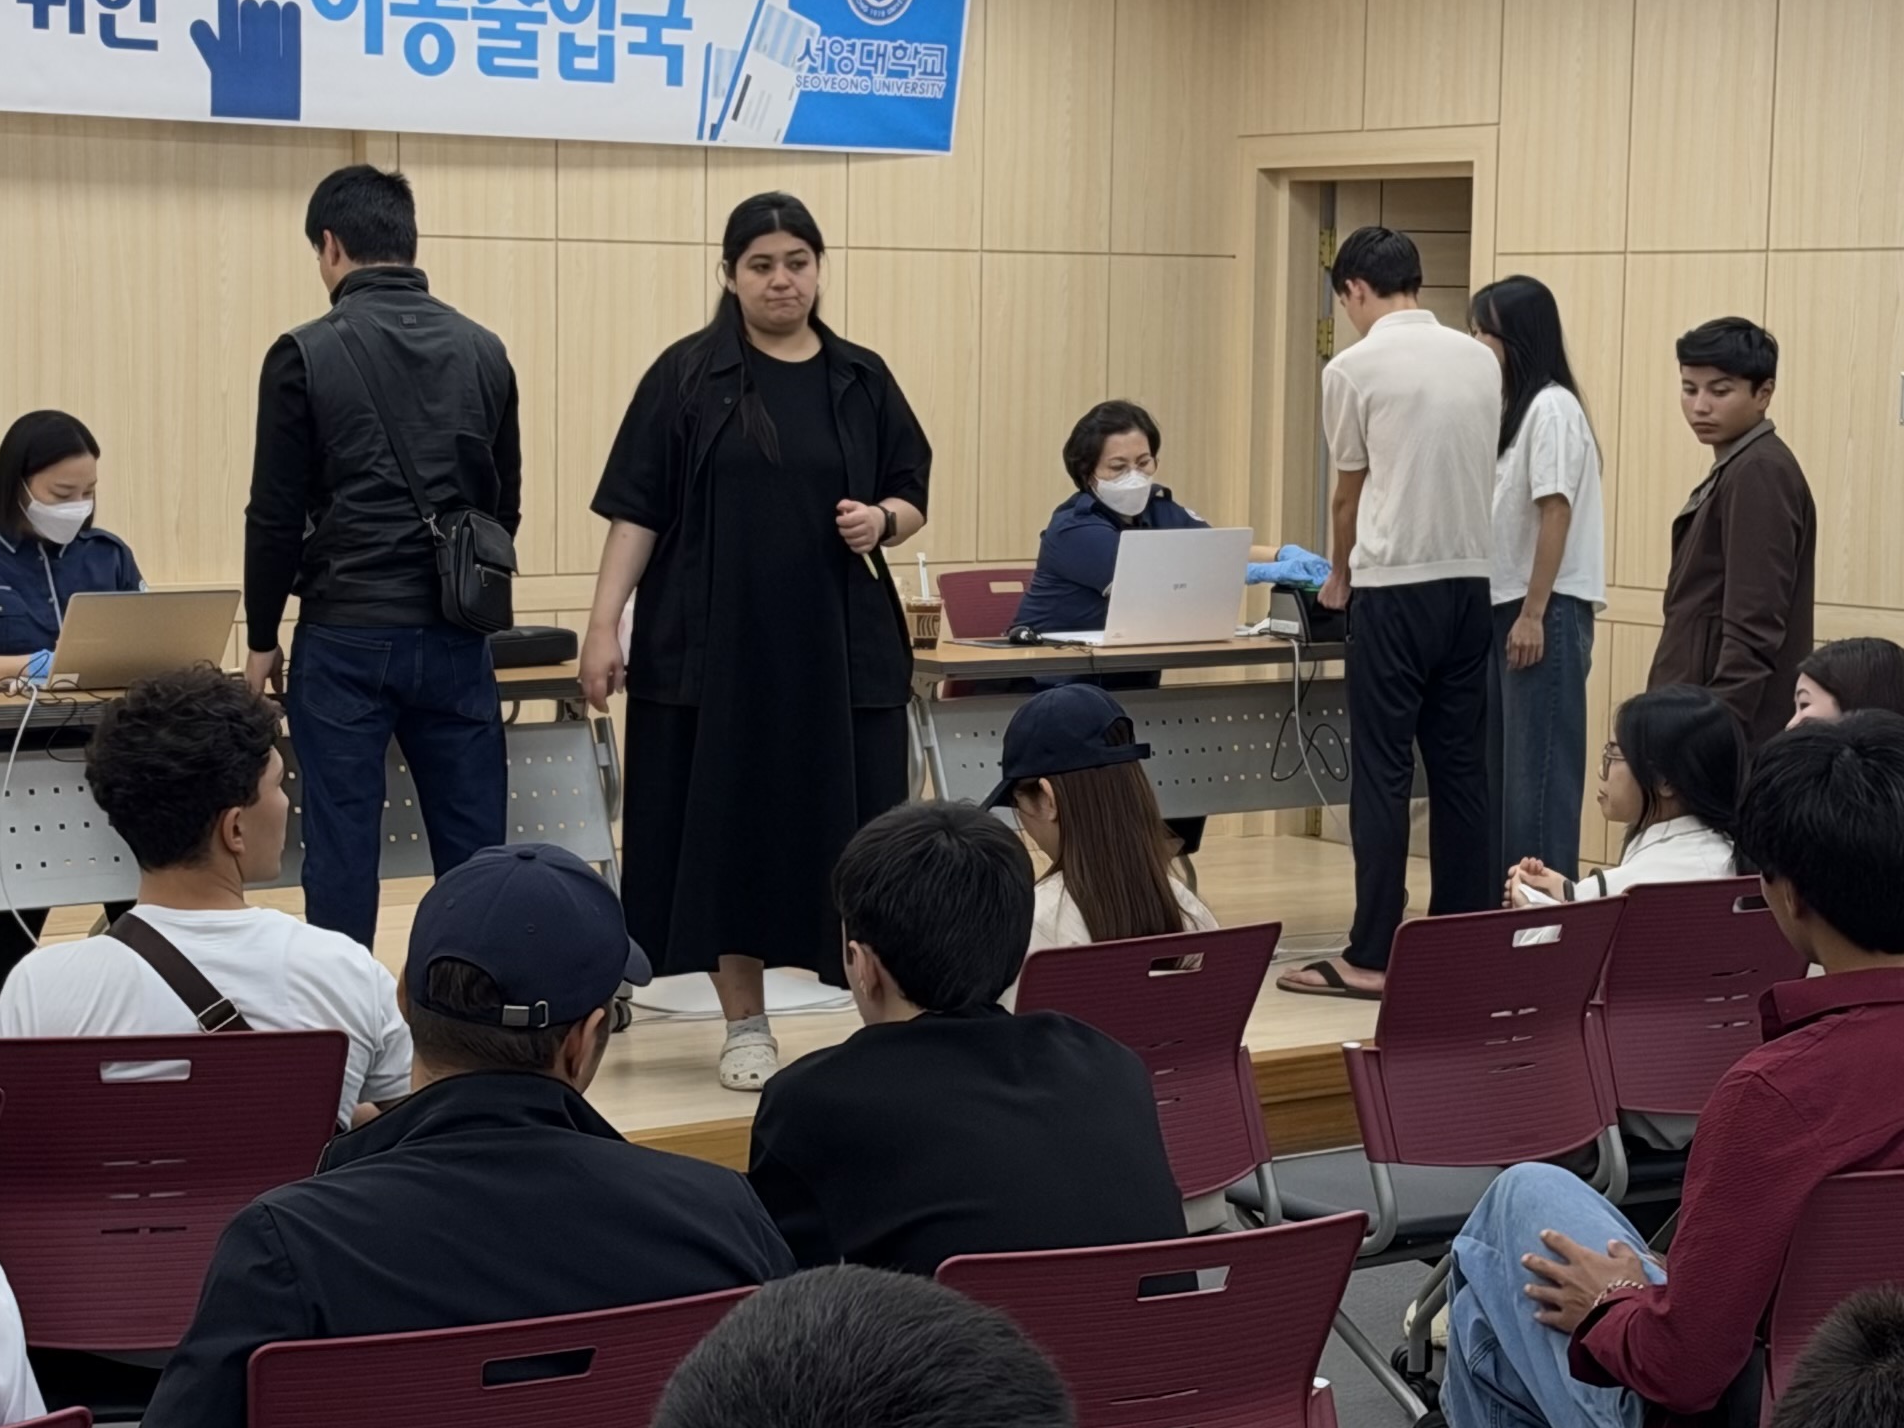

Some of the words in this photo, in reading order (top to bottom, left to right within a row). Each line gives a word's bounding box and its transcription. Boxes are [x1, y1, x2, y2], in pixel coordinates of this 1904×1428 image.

[796, 37, 947, 79] 서영대학교
[795, 74, 870, 93] SEOYEONG
[874, 78, 946, 98] UNIVERSITY
